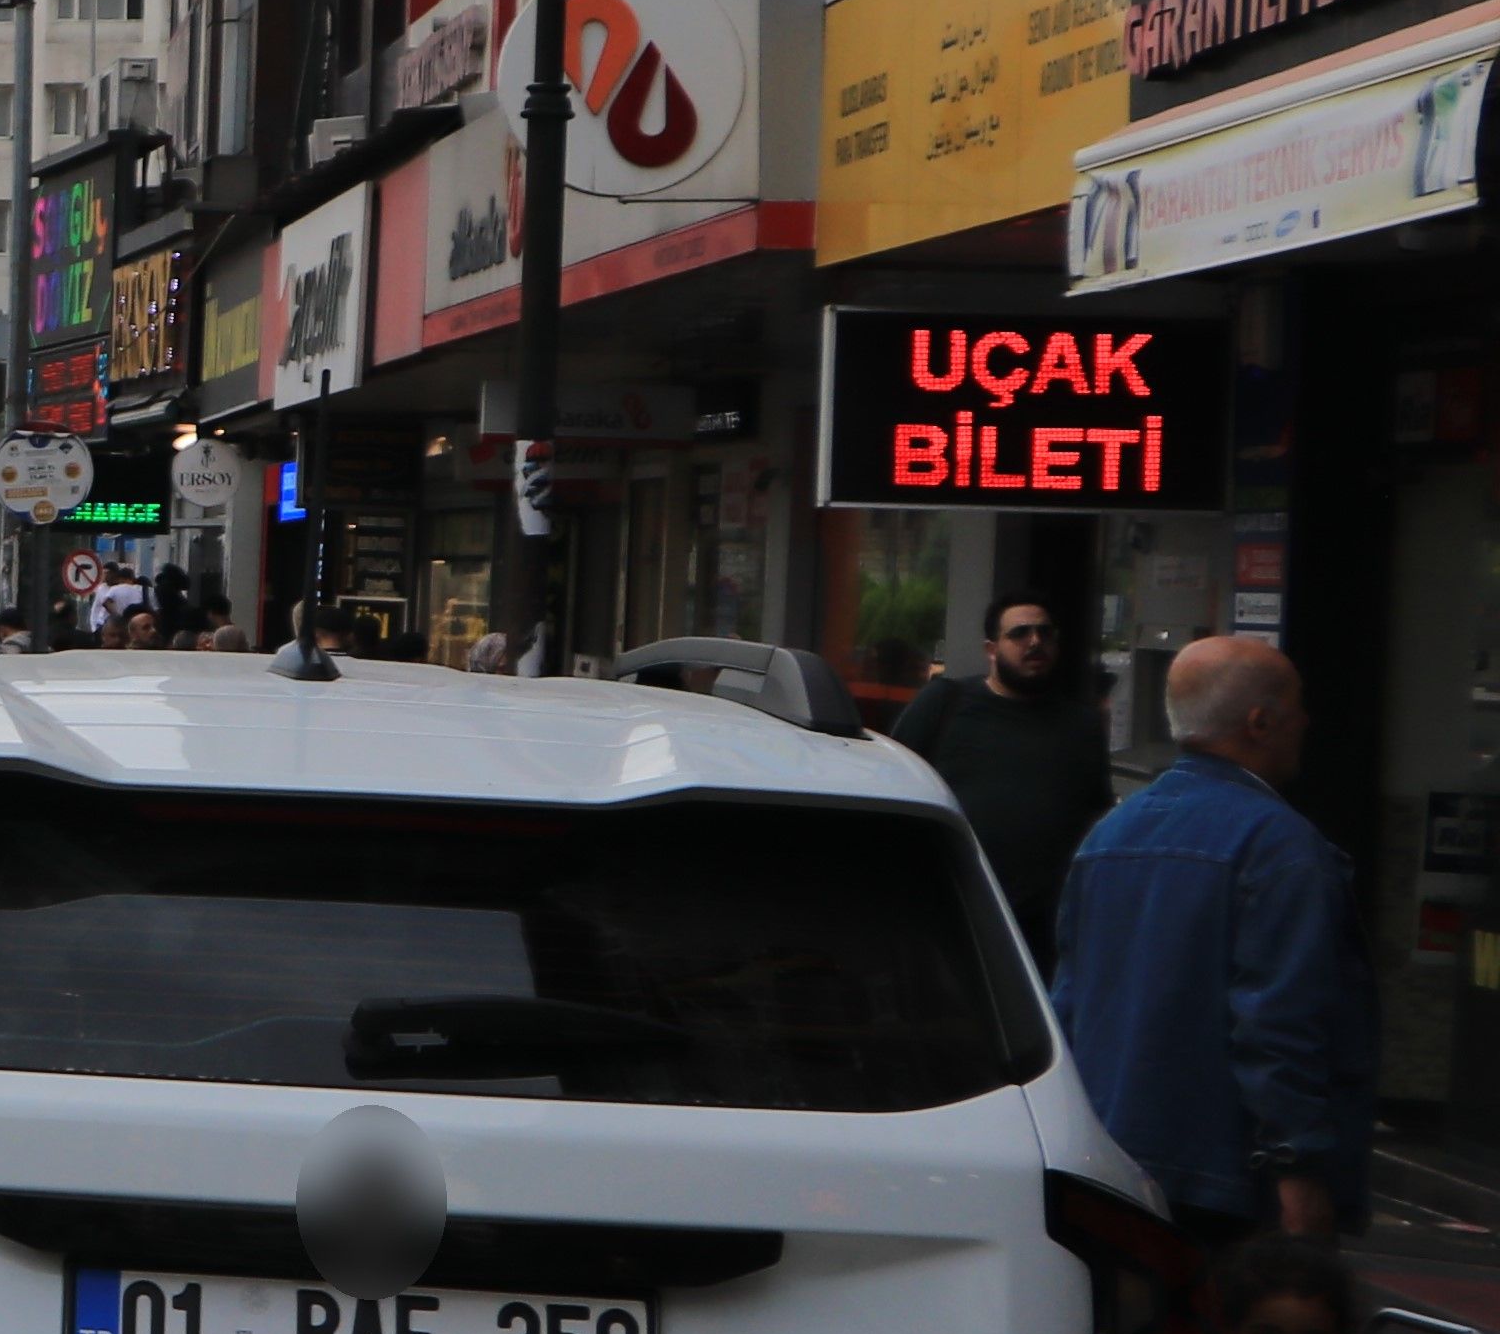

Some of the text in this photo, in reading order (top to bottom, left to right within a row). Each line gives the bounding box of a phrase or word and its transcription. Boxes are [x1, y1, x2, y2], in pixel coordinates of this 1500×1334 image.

[911, 329, 1154, 408] UÇAK
[180, 471, 234, 487] ERSOY
[893, 410, 1164, 493] BİLETİ
